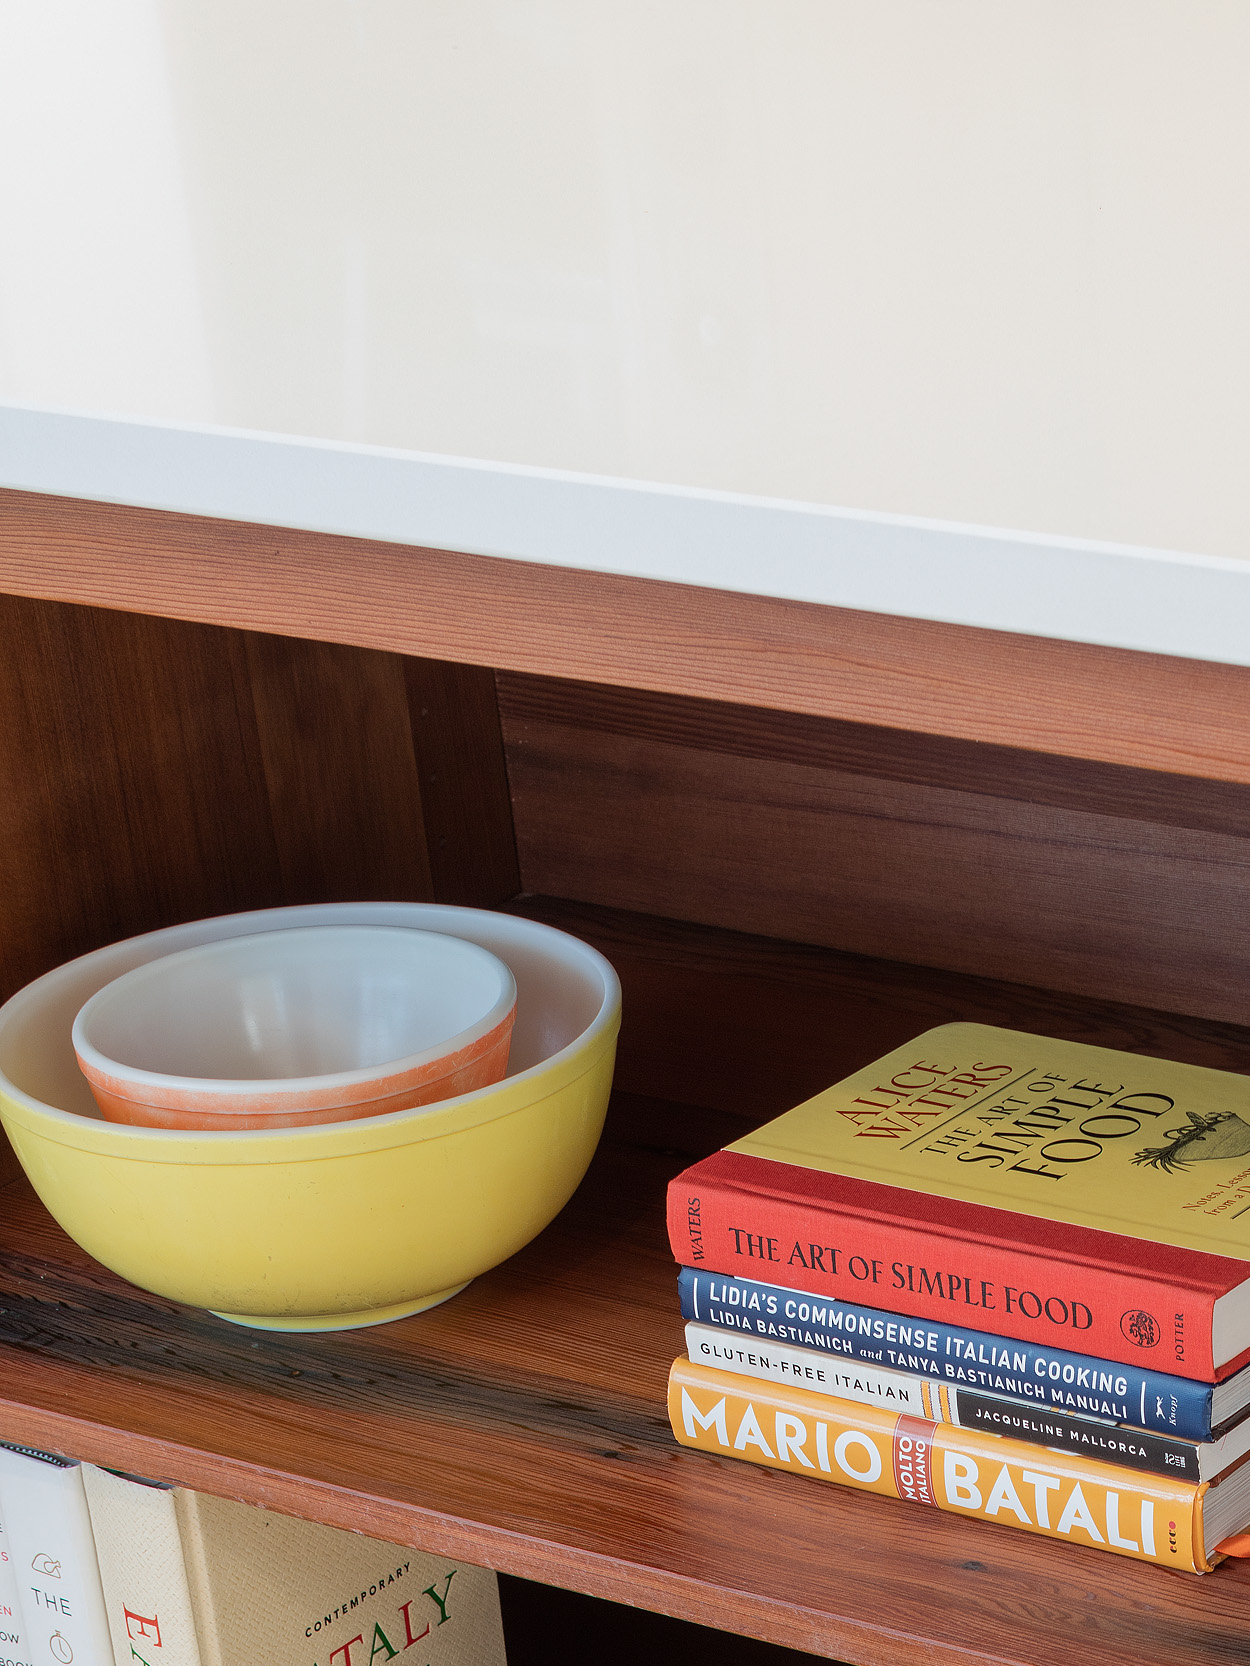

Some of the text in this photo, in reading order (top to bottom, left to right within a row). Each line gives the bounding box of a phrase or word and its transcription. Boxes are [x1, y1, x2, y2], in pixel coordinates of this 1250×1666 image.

[836, 1061, 958, 1126] ALICE
[854, 1062, 1012, 1139] WATERS
[920, 1073, 1068, 1154] THE ART OF
[957, 1079, 1125, 1168] SIMPLE
[1006, 1093, 1175, 1181] FOOD
[688, 1198, 705, 1261] WATERS
[1182, 1190, 1224, 1211] Notes,
[1204, 1200, 1236, 1216] from
[729, 1228, 1092, 1330] THE ART OF SIMPLE FOOD
[710, 1282, 1127, 1396] LIDIA'S COMMONSENSE ITALIAN COOKING
[710, 1309, 1127, 1419] LIDIA BASTIANICH and TANYA BASTIANICH MANUALI
[1175, 1313, 1184, 1361] POTTER
[701, 1343, 909, 1402] GLUTEN-FREE ITALIAN
[976, 1408, 1147, 1457] JACQUELINE MALLORCA
[1169, 1394, 1177, 1426] Knopf
[682, 1386, 1156, 1556] MARIO BATALI
[900, 1437, 917, 1500] MOLTO
[915, 1440, 931, 1504] ITALIANO
[31, 1588, 72, 1616] THE
[305, 1562, 410, 1638] CONTEMPORARY
